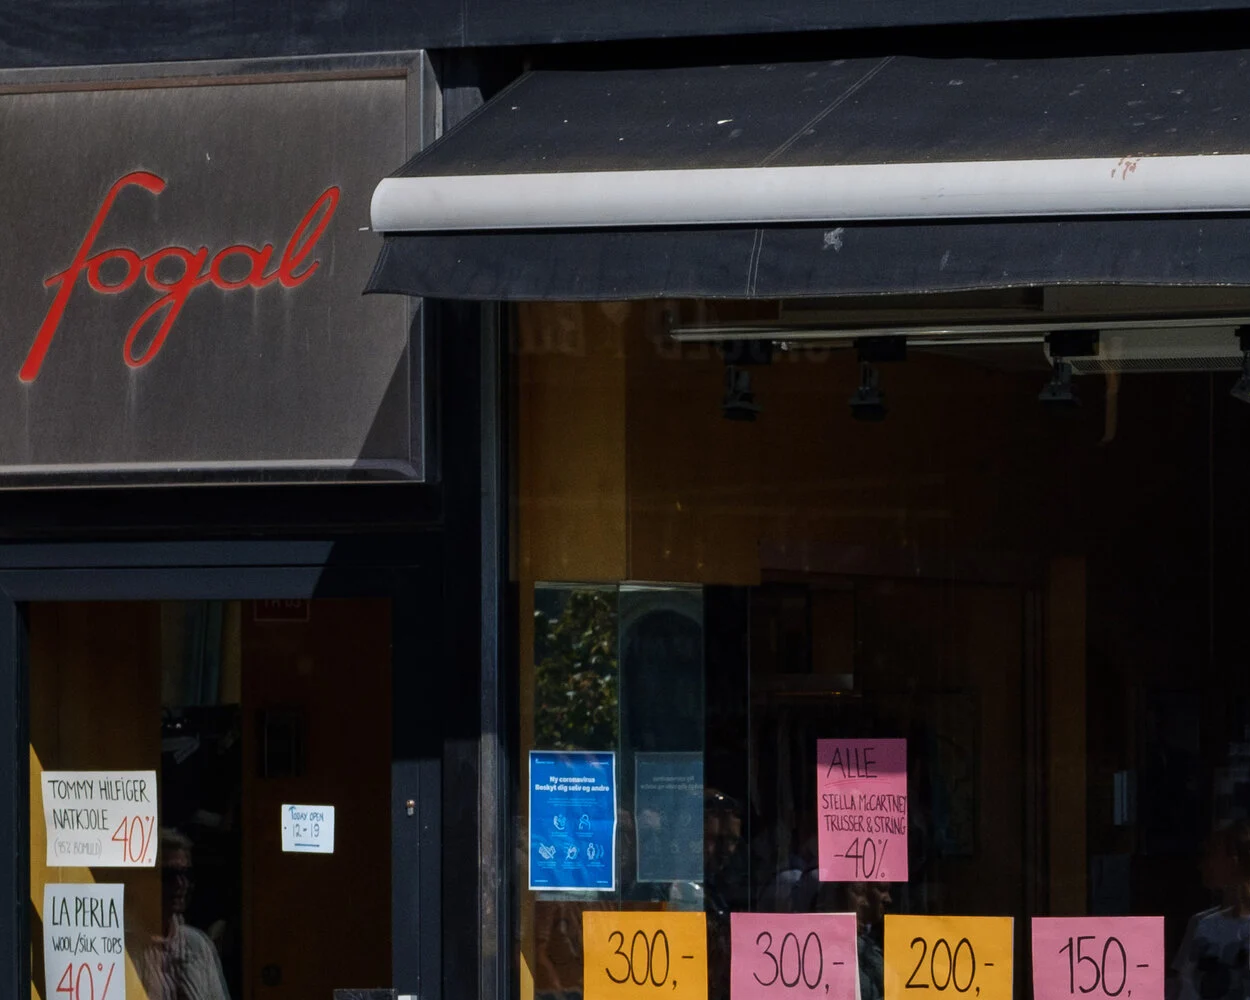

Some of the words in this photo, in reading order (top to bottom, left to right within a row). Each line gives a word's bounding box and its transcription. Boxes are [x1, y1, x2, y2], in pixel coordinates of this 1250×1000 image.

[19, 170, 340, 383] fogal
[826, 747, 878, 778] ALLE
[48, 779, 94, 800] TOMMY
[559, 776, 595, 784] coronavirus
[310, 811, 324, 822] OPEN
[822, 794, 856, 811] STELLA
[112, 815, 155, 864] 40%
[824, 815, 865, 832] TRUSSER
[867, 817, 874, 833] &
[874, 815, 906, 835] STRING
[833, 836, 889, 879] -40%
[52, 896, 71, 927] LA
[75, 896, 120, 928] PERLA
[101, 936, 122, 954] TOPS
[605, 929, 694, 991] 300,-
[752, 931, 845, 994] 300,-
[905, 936, 995, 998] 200,-
[1058, 935, 1149, 998] 150,-
